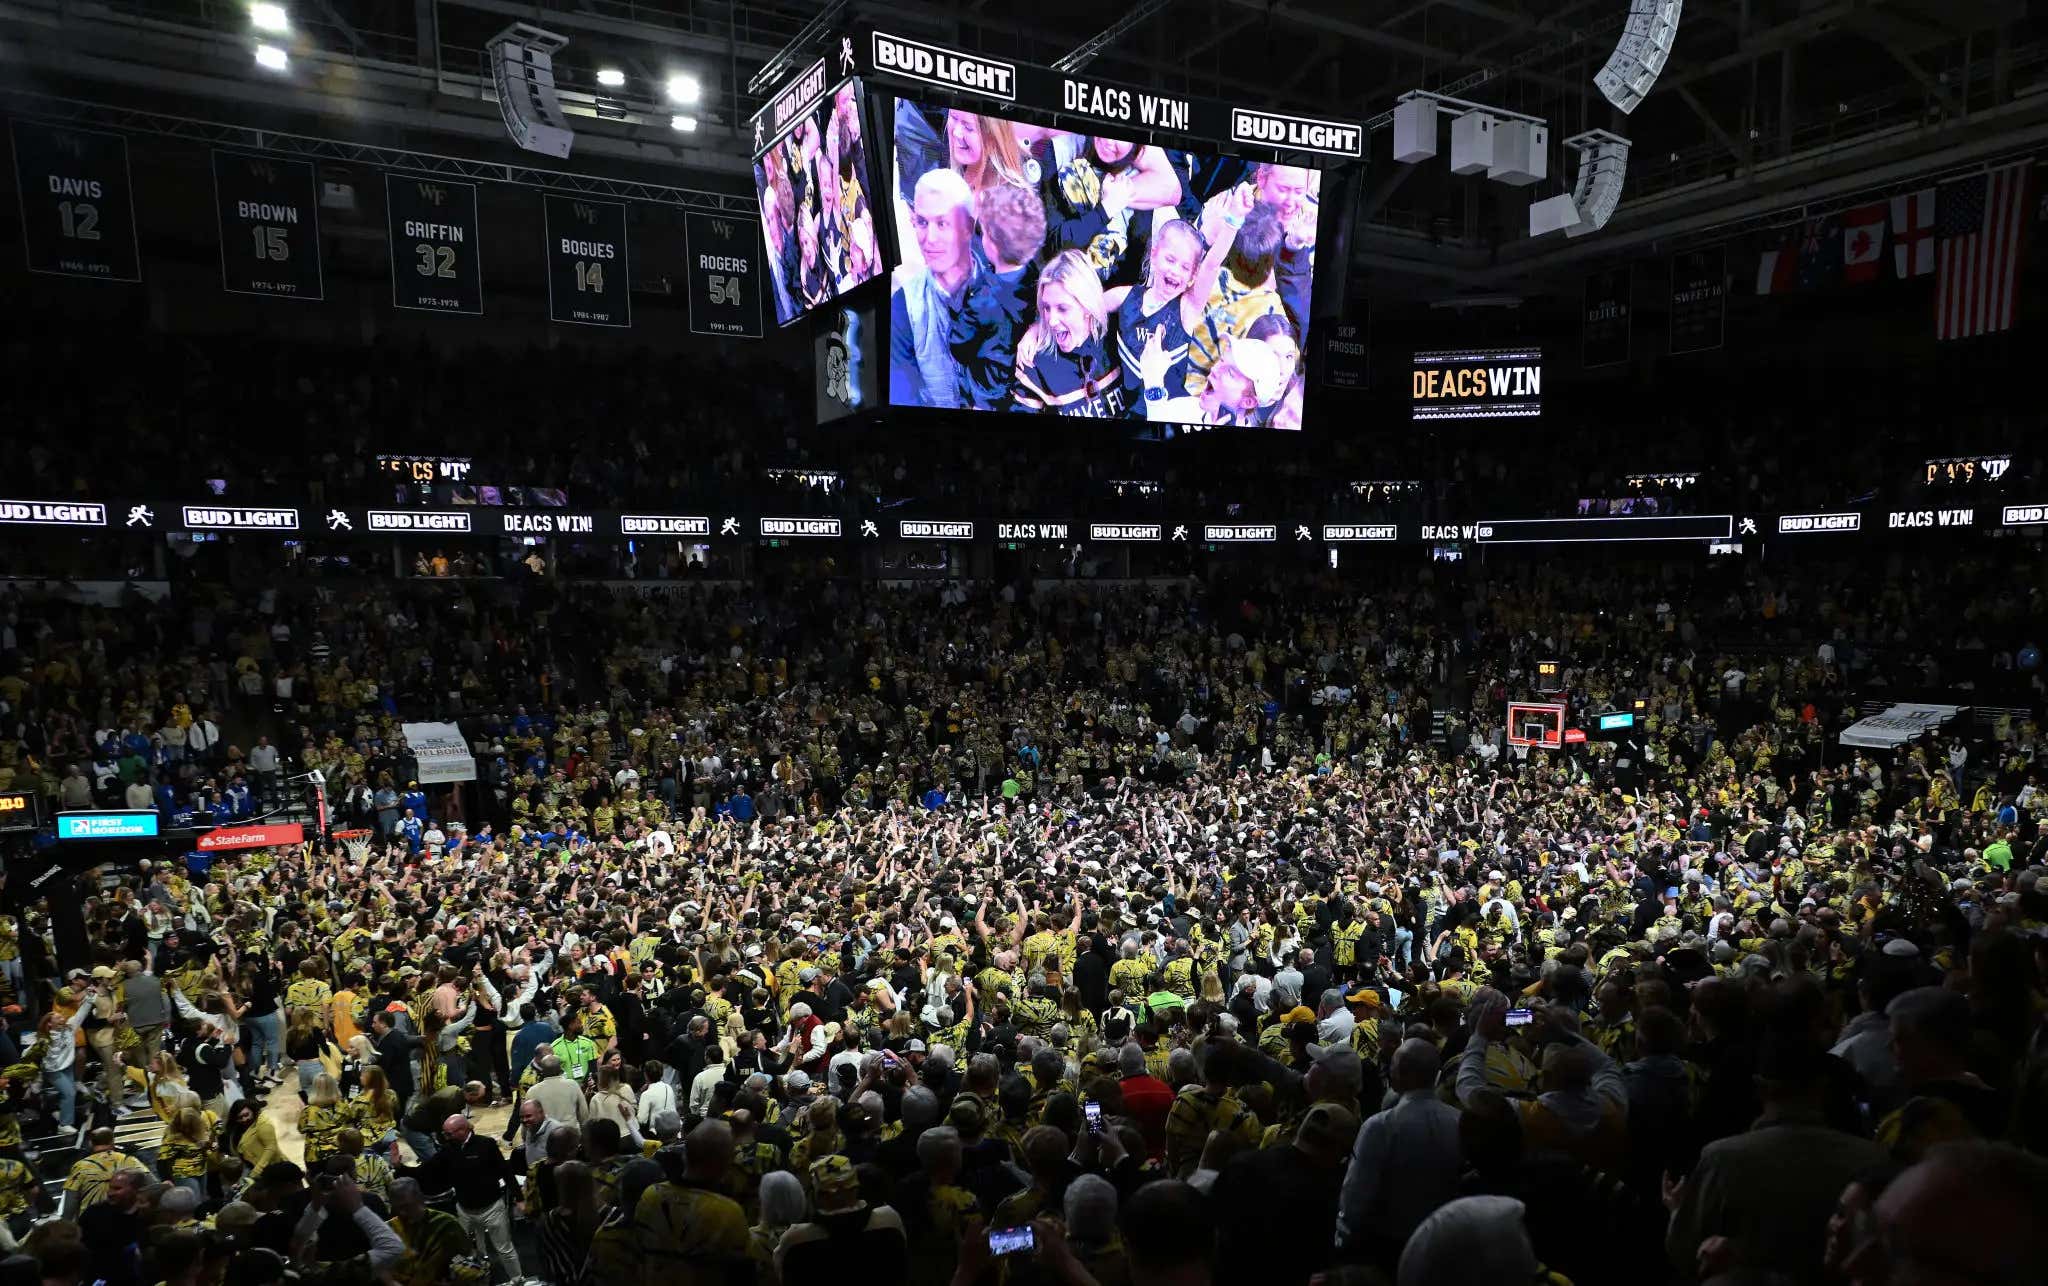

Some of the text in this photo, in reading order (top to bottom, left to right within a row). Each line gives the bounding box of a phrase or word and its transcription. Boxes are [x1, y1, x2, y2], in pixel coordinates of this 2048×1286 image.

[878, 39, 933, 75] BUD
[776, 66, 825, 126] BUD LIGHT
[1064, 78, 1189, 130] DEACS WIN!
[1237, 115, 1285, 142] BUD
[49, 174, 103, 200] DAVIS
[58, 200, 102, 241] 12
[239, 200, 298, 224] BROWN
[405, 219, 463, 242] GRIFFIN
[253, 225, 289, 262] 15
[561, 238, 615, 260] BOGUES
[416, 244, 457, 279] 32
[699, 254, 748, 274] ROGERS
[576, 261, 604, 294] 14
[708, 275, 741, 306] 54
[33, 505, 101, 521] LIGHT
[188, 510, 294, 526] BUD LIGHT
[372, 514, 467, 529] BUD LIGHT
[1888, 509, 1973, 528] DEACS WIN!
[2006, 508, 2043, 522] BUD
[503, 514, 593, 532] DEACS WIN!
[625, 518, 706, 532] BUD LIGHT
[764, 521, 838, 534] BUD LIGHT
[903, 524, 970, 536] BUD LIGHT
[998, 524, 1068, 539] DEACS WIN!
[1421, 525, 1459, 539] DEACS
[1782, 516, 1858, 530] BUD LIGHT
[1093, 527, 1159, 538] BUD LIGHT
[1207, 528, 1273, 539] BUD LIGHT
[1326, 527, 1394, 538] BUD LIGHT
[91, 818, 122, 827] FIRST
[91, 826, 144, 835] HORIZON
